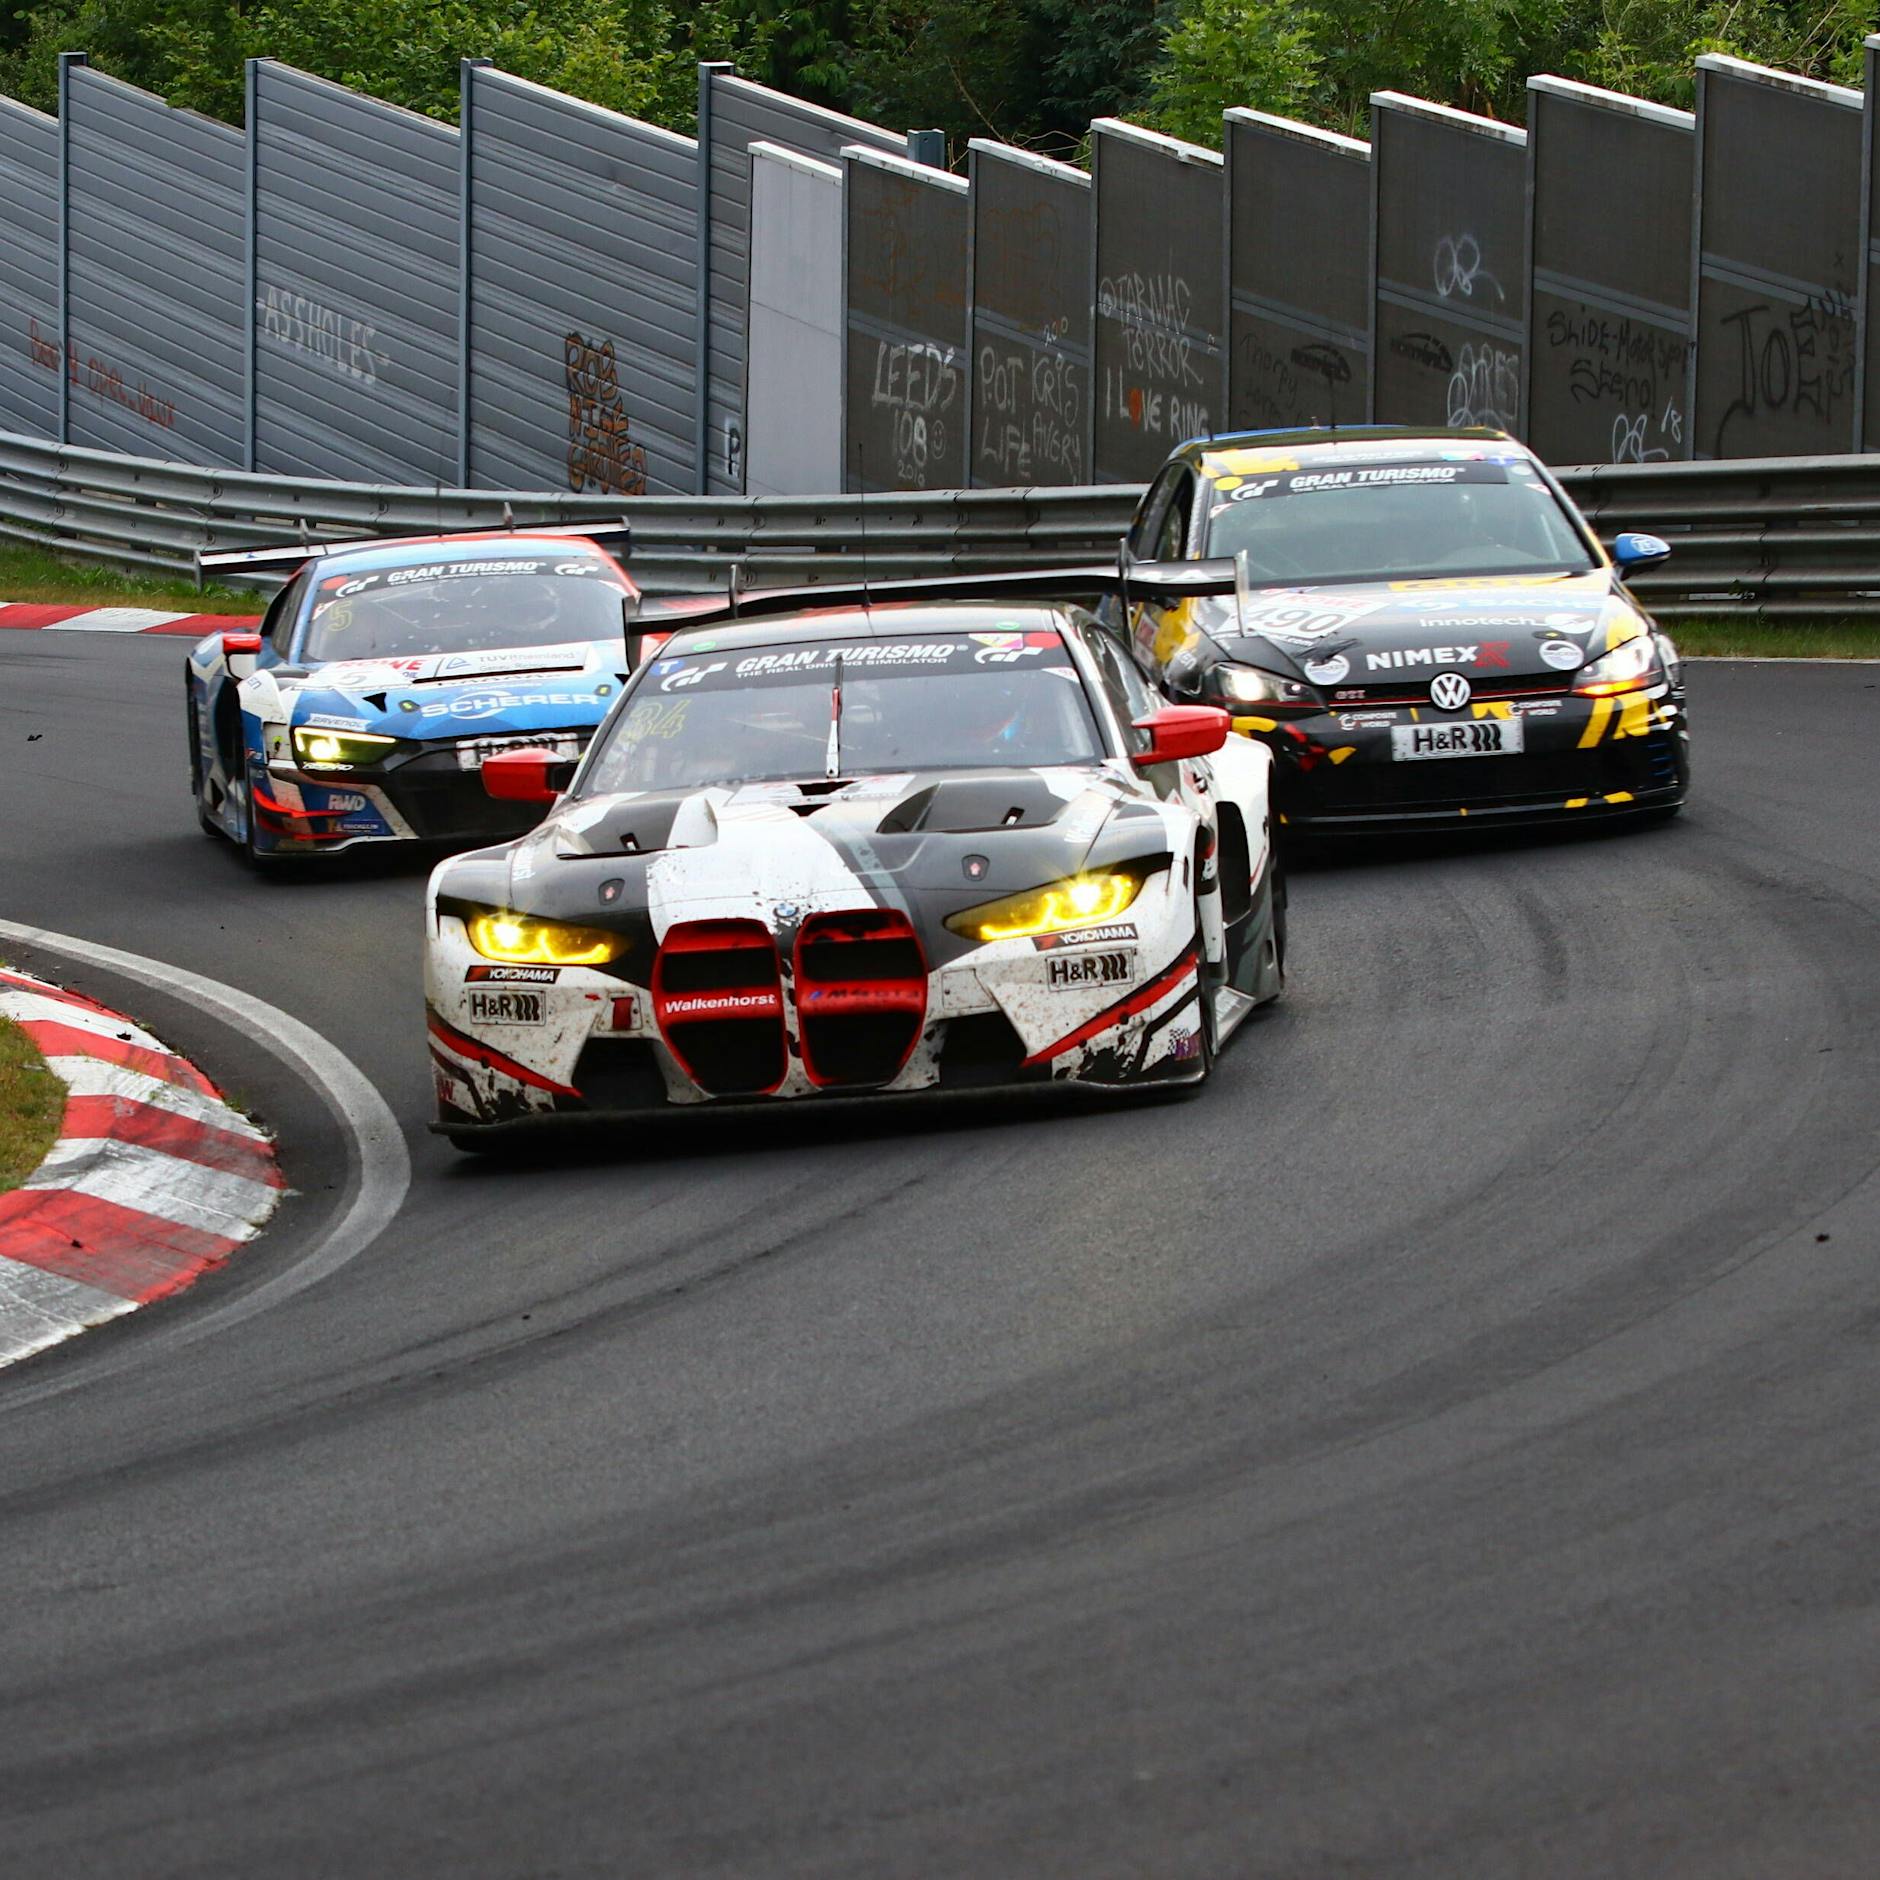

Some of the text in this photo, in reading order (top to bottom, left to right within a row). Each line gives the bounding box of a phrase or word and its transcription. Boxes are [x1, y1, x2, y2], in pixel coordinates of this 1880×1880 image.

[1122, 326, 1204, 388] TERROR
[1290, 472, 1353, 489] GRAN
[387, 565, 445, 583] GRAN
[327, 601, 353, 633] 5
[1419, 617, 1536, 628] Innotech
[735, 650, 820, 673] GRAN
[736, 670, 762, 679] THE
[766, 665, 803, 675] REAL
[866, 657, 948, 666] SIMULATOR
[421, 693, 600, 718] SCHERER
[1414, 727, 1468, 752] H&R
[1060, 926, 1137, 945] YOKOHAMA
[488, 967, 558, 982] YOKOHAMA
[1050, 958, 1098, 985] H&R
[472, 992, 512, 1019] H&R
[665, 994, 776, 1014] Walkenhorst
